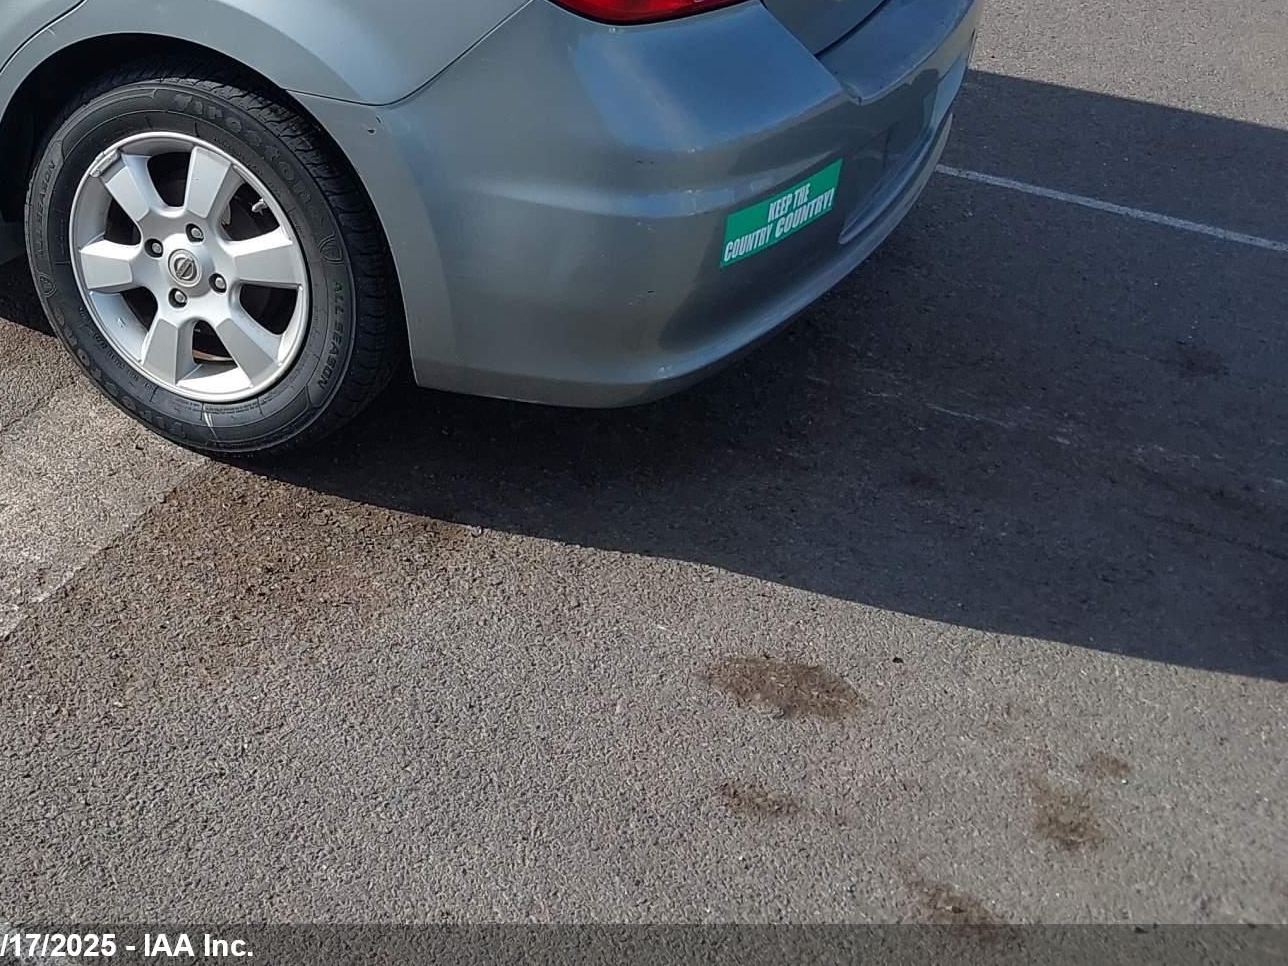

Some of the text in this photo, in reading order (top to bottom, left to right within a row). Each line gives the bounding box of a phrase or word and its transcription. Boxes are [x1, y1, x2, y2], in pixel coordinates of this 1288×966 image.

[171, 91, 318, 212] Fireston
[723, 188, 836, 263] COUNTRY COUNTRY!
[768, 182, 812, 223] KEEP THE
[315, 281, 345, 391] ALL SEASON
